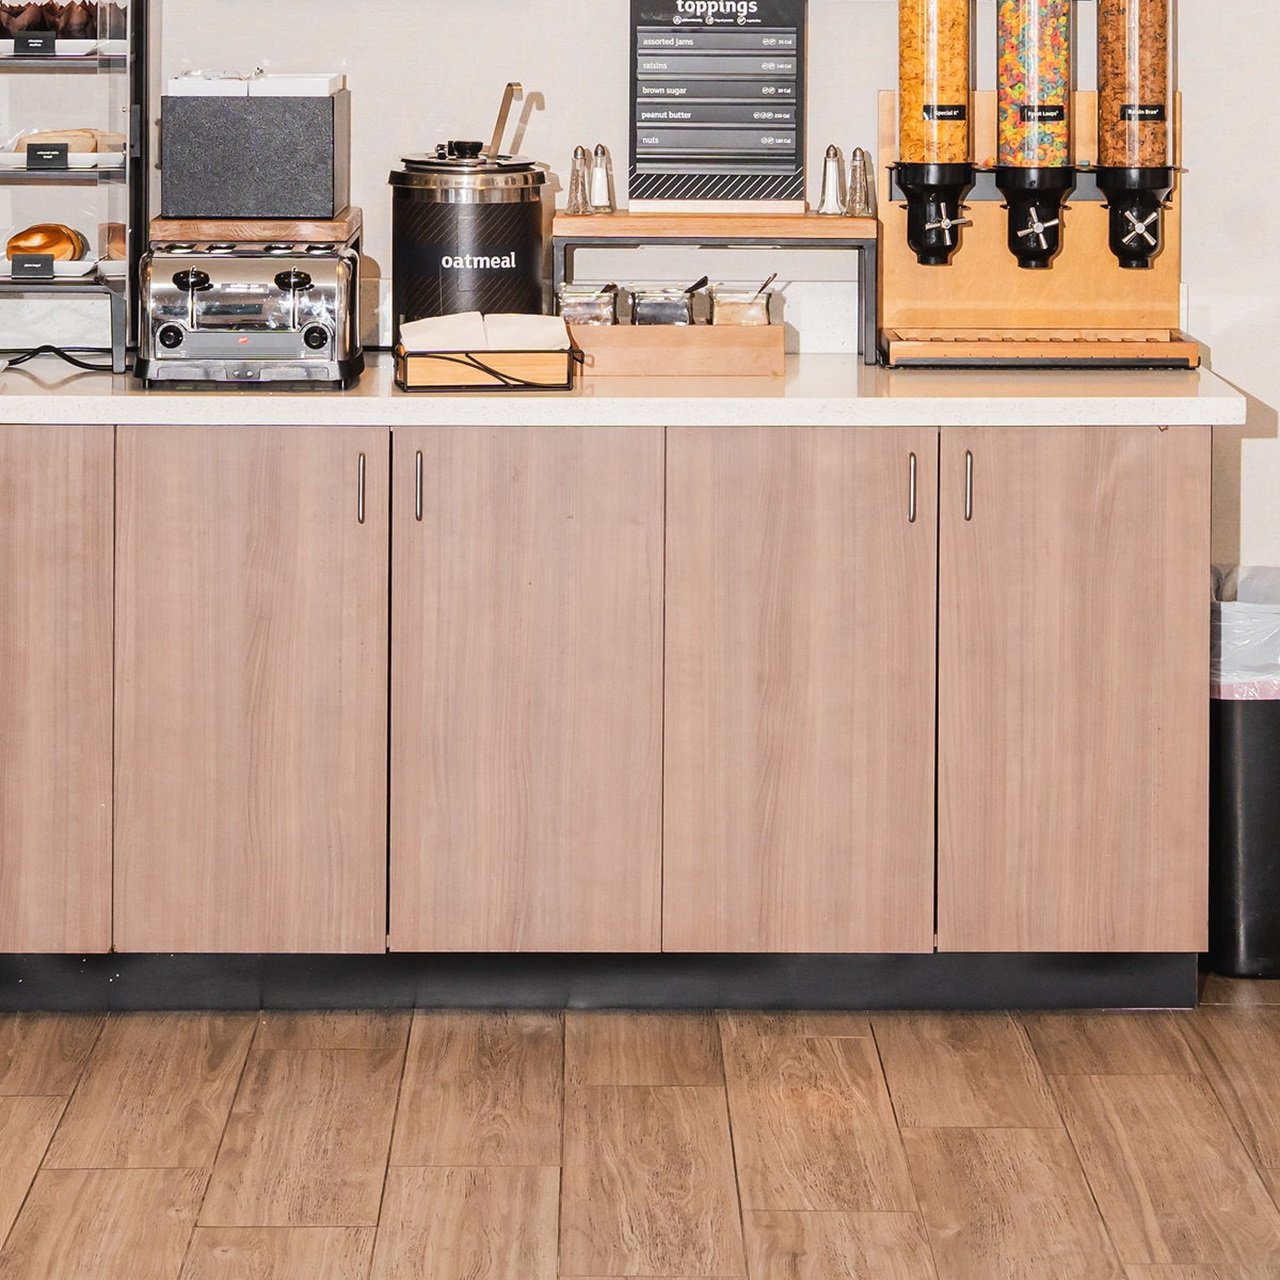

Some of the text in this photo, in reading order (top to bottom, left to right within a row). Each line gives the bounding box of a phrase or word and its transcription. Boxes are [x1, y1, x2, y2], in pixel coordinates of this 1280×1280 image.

[642, 37, 694, 48] assorted jams
[642, 61, 668, 70] raisins
[642, 86, 688, 96] brown sugar
[641, 110, 692, 120] peanut butter
[642, 136, 660, 145] nuts
[441, 252, 516, 269] oatmeal
